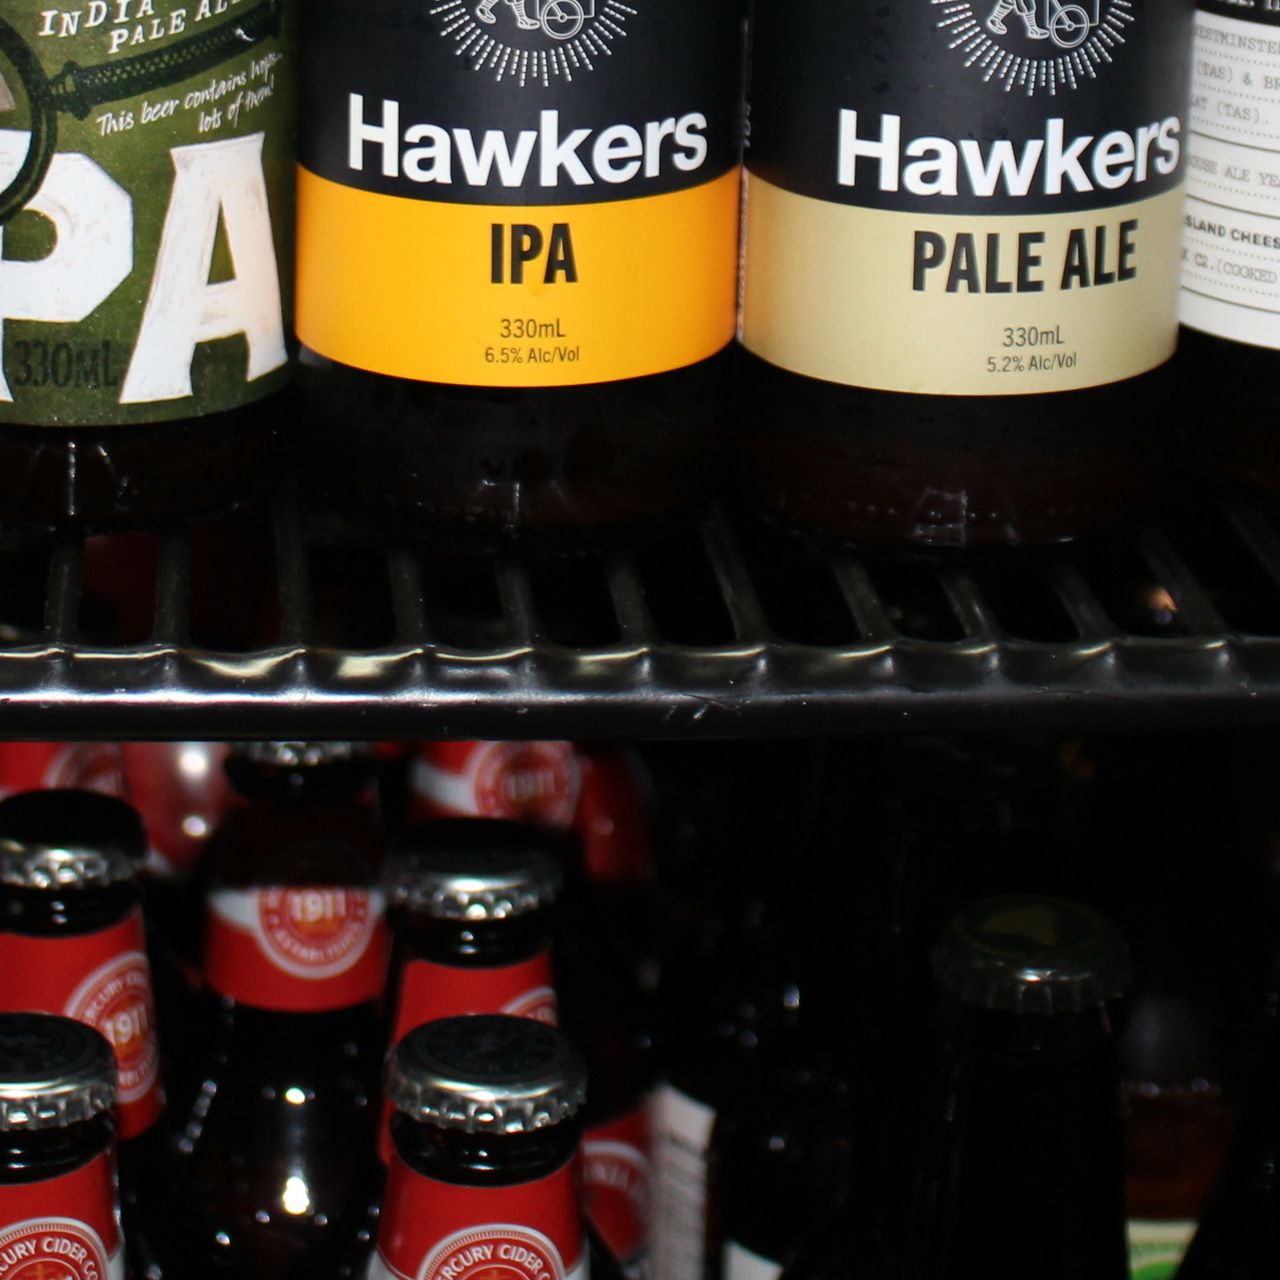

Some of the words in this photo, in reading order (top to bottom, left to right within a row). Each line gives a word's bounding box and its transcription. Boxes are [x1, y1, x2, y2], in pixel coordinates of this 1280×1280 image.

[107, 8, 187, 54] PALE
[1243, 72, 1253, 86] &
[96, 111, 135, 136] This
[141, 97, 179, 124] beer
[184, 72, 247, 110] contains
[198, 107, 223, 134] lots
[227, 90, 244, 129] of
[348, 92, 708, 187] Hawkers
[836, 108, 1181, 197] Hawkers
[1224, 165, 1251, 183] ALE
[1186, 215, 1227, 238] SLAND
[489, 222, 580, 285] IPA
[913, 229, 1046, 294] PALE
[1060, 218, 1140, 290] ALE
[499, 317, 567, 339] 330mL
[1002, 325, 1065, 348] 330mL
[484, 346, 524, 365] 6.5%
[527, 345, 581, 365] Alc/Vol
[986, 355, 1026, 374] 5.2%
[1028, 351, 1078, 373] Alc/Vol
[289, 887, 346, 923] 1911
[42, 1237, 89, 1265] CIDER
[499, 1244, 544, 1274] CIDER
